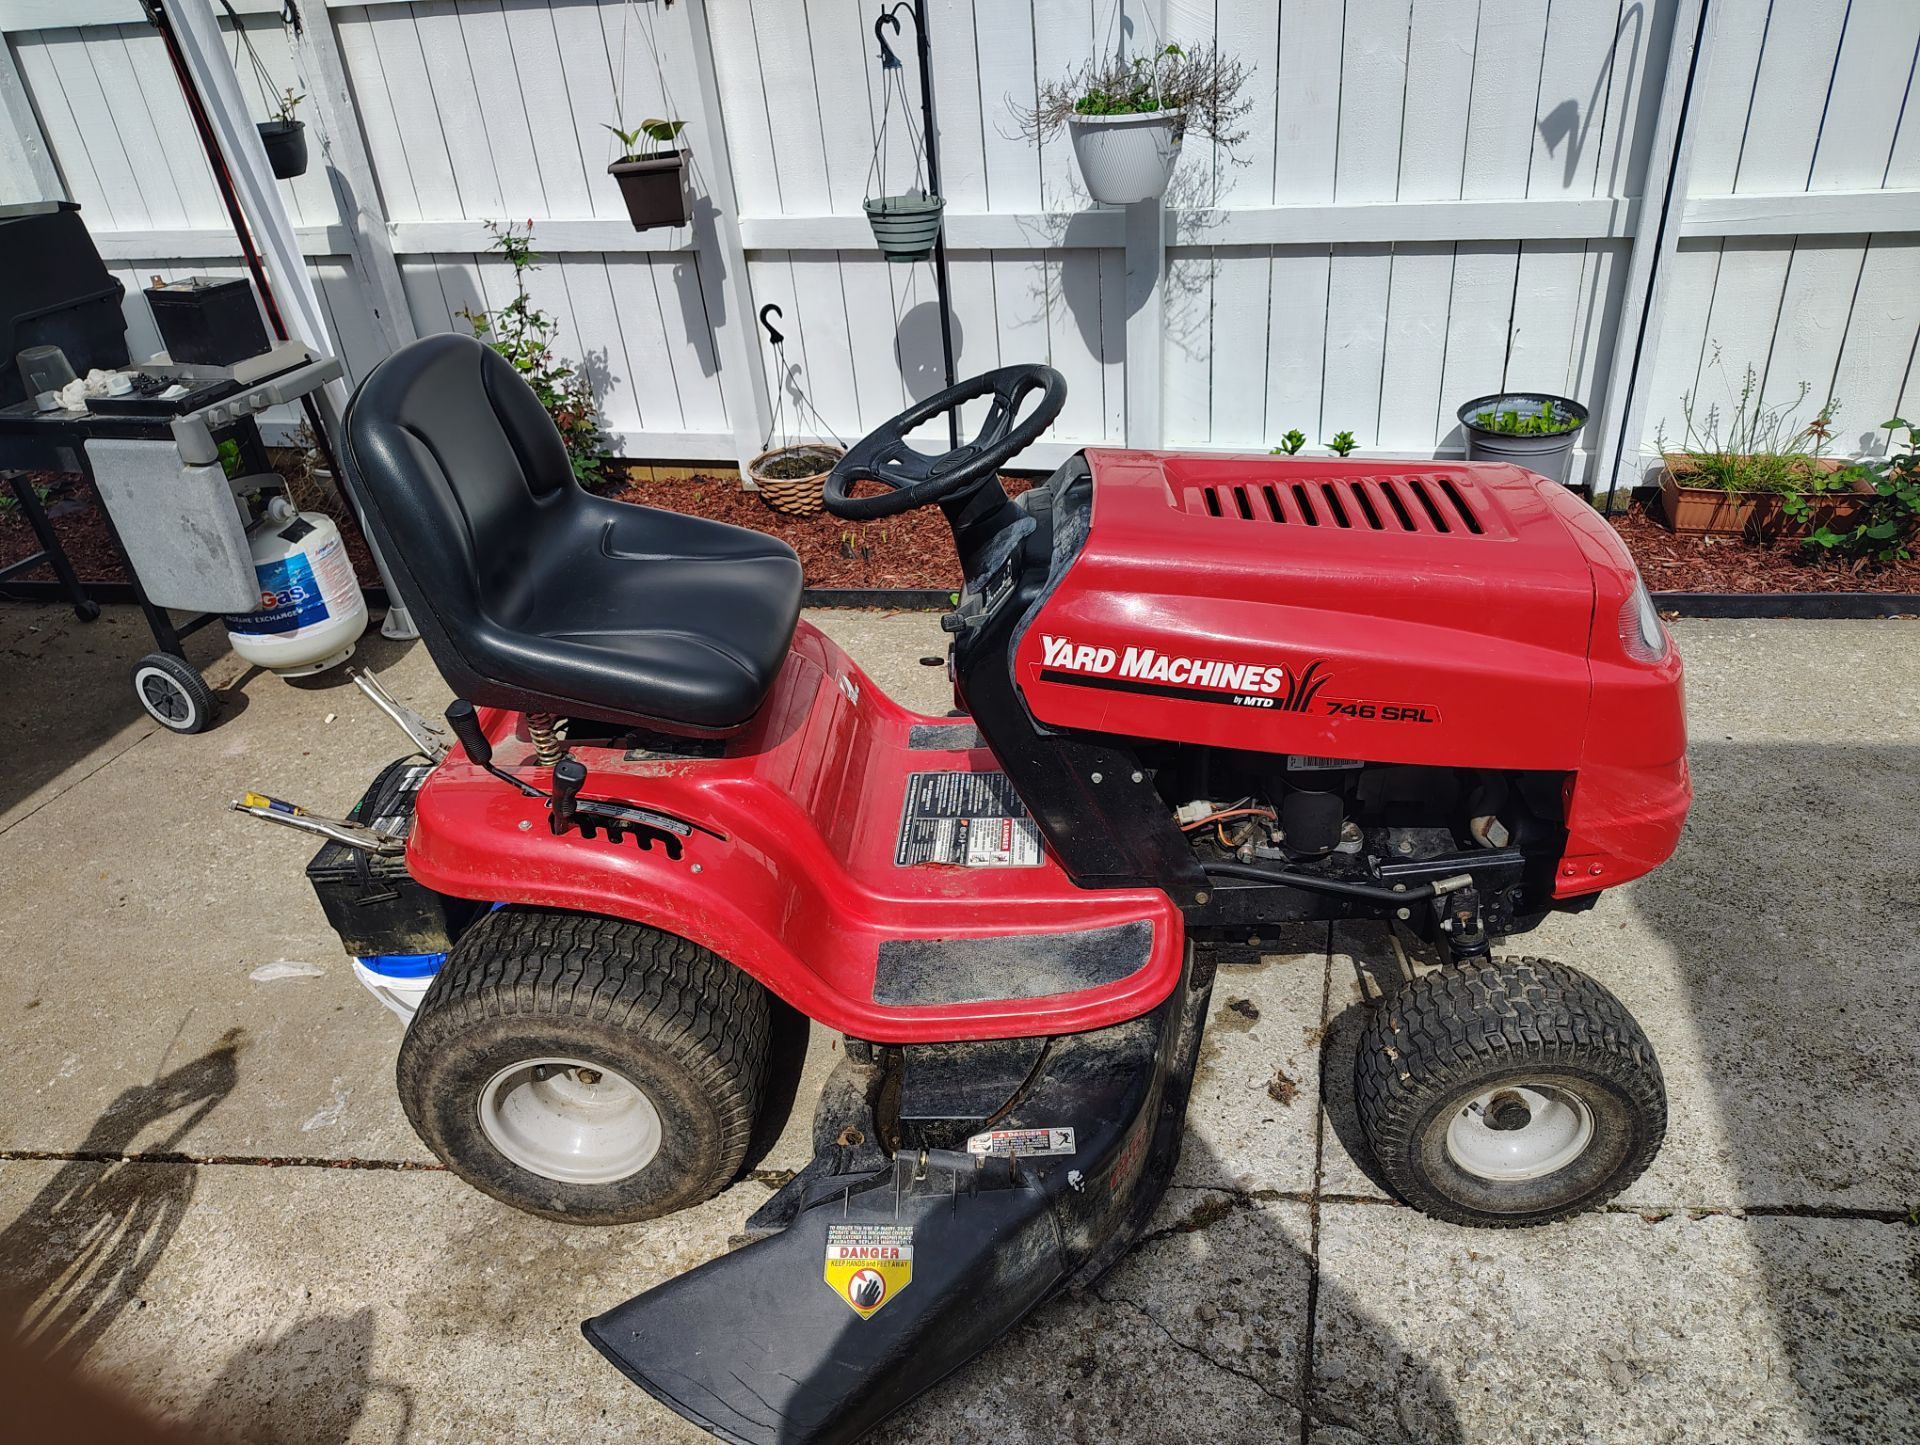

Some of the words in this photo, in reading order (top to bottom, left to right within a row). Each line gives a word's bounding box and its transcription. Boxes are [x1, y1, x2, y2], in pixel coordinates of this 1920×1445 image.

[255, 611, 298, 623] EXCHANGE
[1042, 636, 1117, 674] YARD
[1118, 647, 1284, 693] MACHINES
[1233, 696, 1242, 706] by
[1243, 698, 1274, 708] MTD
[1326, 702, 1376, 718] 746
[1380, 707, 1434, 723] SRL
[1002, 825, 1010, 850] DANGER
[840, 1248, 899, 1258] DANGER
